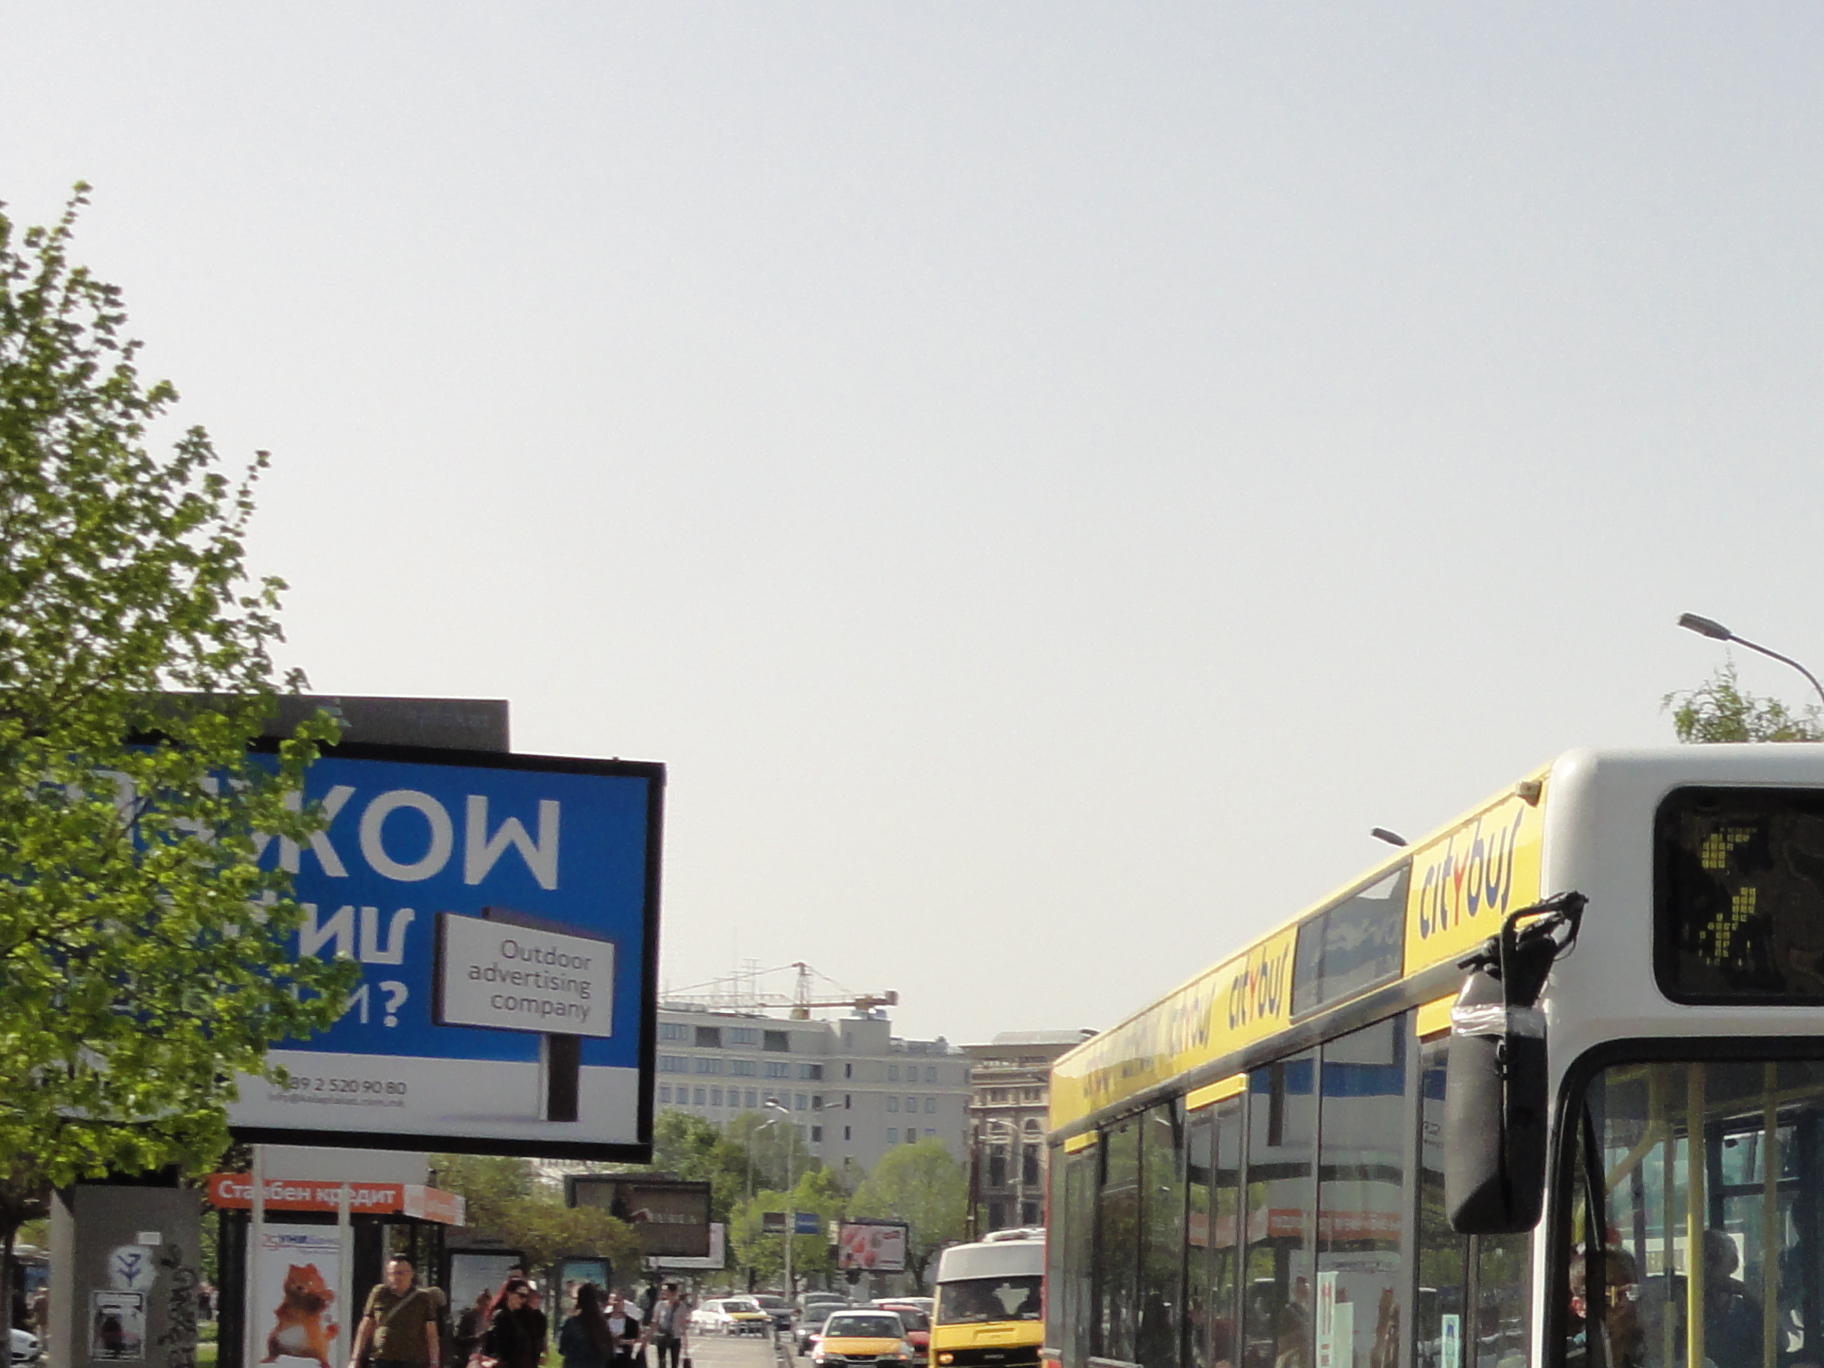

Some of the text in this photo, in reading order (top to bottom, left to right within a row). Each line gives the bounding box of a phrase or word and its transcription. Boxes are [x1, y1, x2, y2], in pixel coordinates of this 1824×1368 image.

[501, 939, 592, 971] Outdoor
[467, 961, 592, 1000] advertising
[490, 993, 592, 1024] company
[313, 1078, 325, 1092] 2
[329, 1078, 360, 1093] 520
[362, 1080, 383, 1094] 90
[217, 1180, 311, 1201] Стабен
